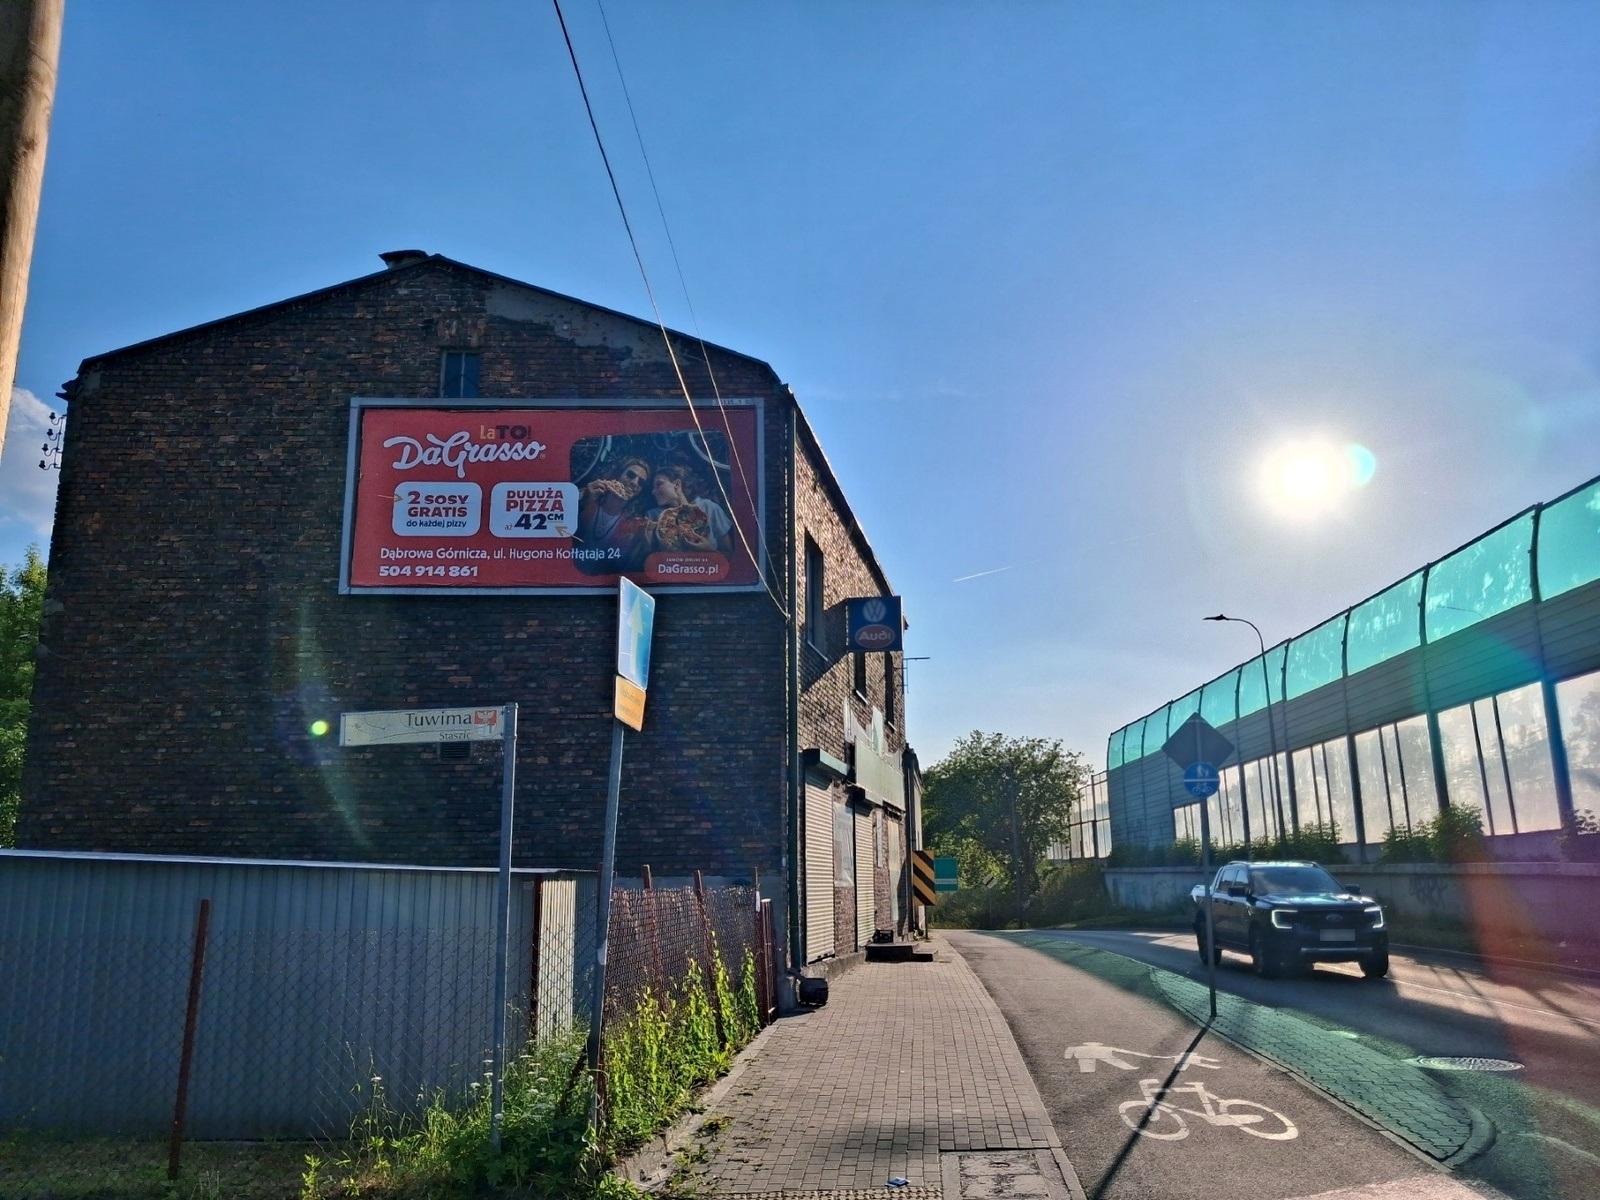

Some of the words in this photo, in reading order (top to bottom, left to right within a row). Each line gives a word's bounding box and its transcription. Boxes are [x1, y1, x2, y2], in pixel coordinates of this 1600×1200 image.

[383, 431, 546, 478] DaGrasso
[407, 491, 421, 505] 2
[424, 494, 469, 505] SOSY
[506, 487, 564, 500] DUUUŻA
[407, 506, 468, 518] GRATIS
[506, 499, 564, 512] PIZZA
[406, 519, 417, 528] do
[419, 519, 445, 530] każdej
[446, 519, 468, 529] pizzy
[514, 513, 548, 531] 42
[547, 513, 564, 522] CM
[380, 547, 433, 561] Dąbrowa
[436, 547, 491, 561] Górnicza,
[493, 547, 506, 560] ul.
[509, 548, 554, 562] Hugona
[556, 547, 606, 562] Kołłątaja
[607, 548, 622, 559] 24
[379, 565, 412, 577] 504
[415, 565, 446, 577] 914
[448, 565, 479, 577] 861
[657, 563, 719, 576] DaGrasso.pl
[858, 630, 891, 641] Audi
[406, 711, 472, 727] Tuwima
